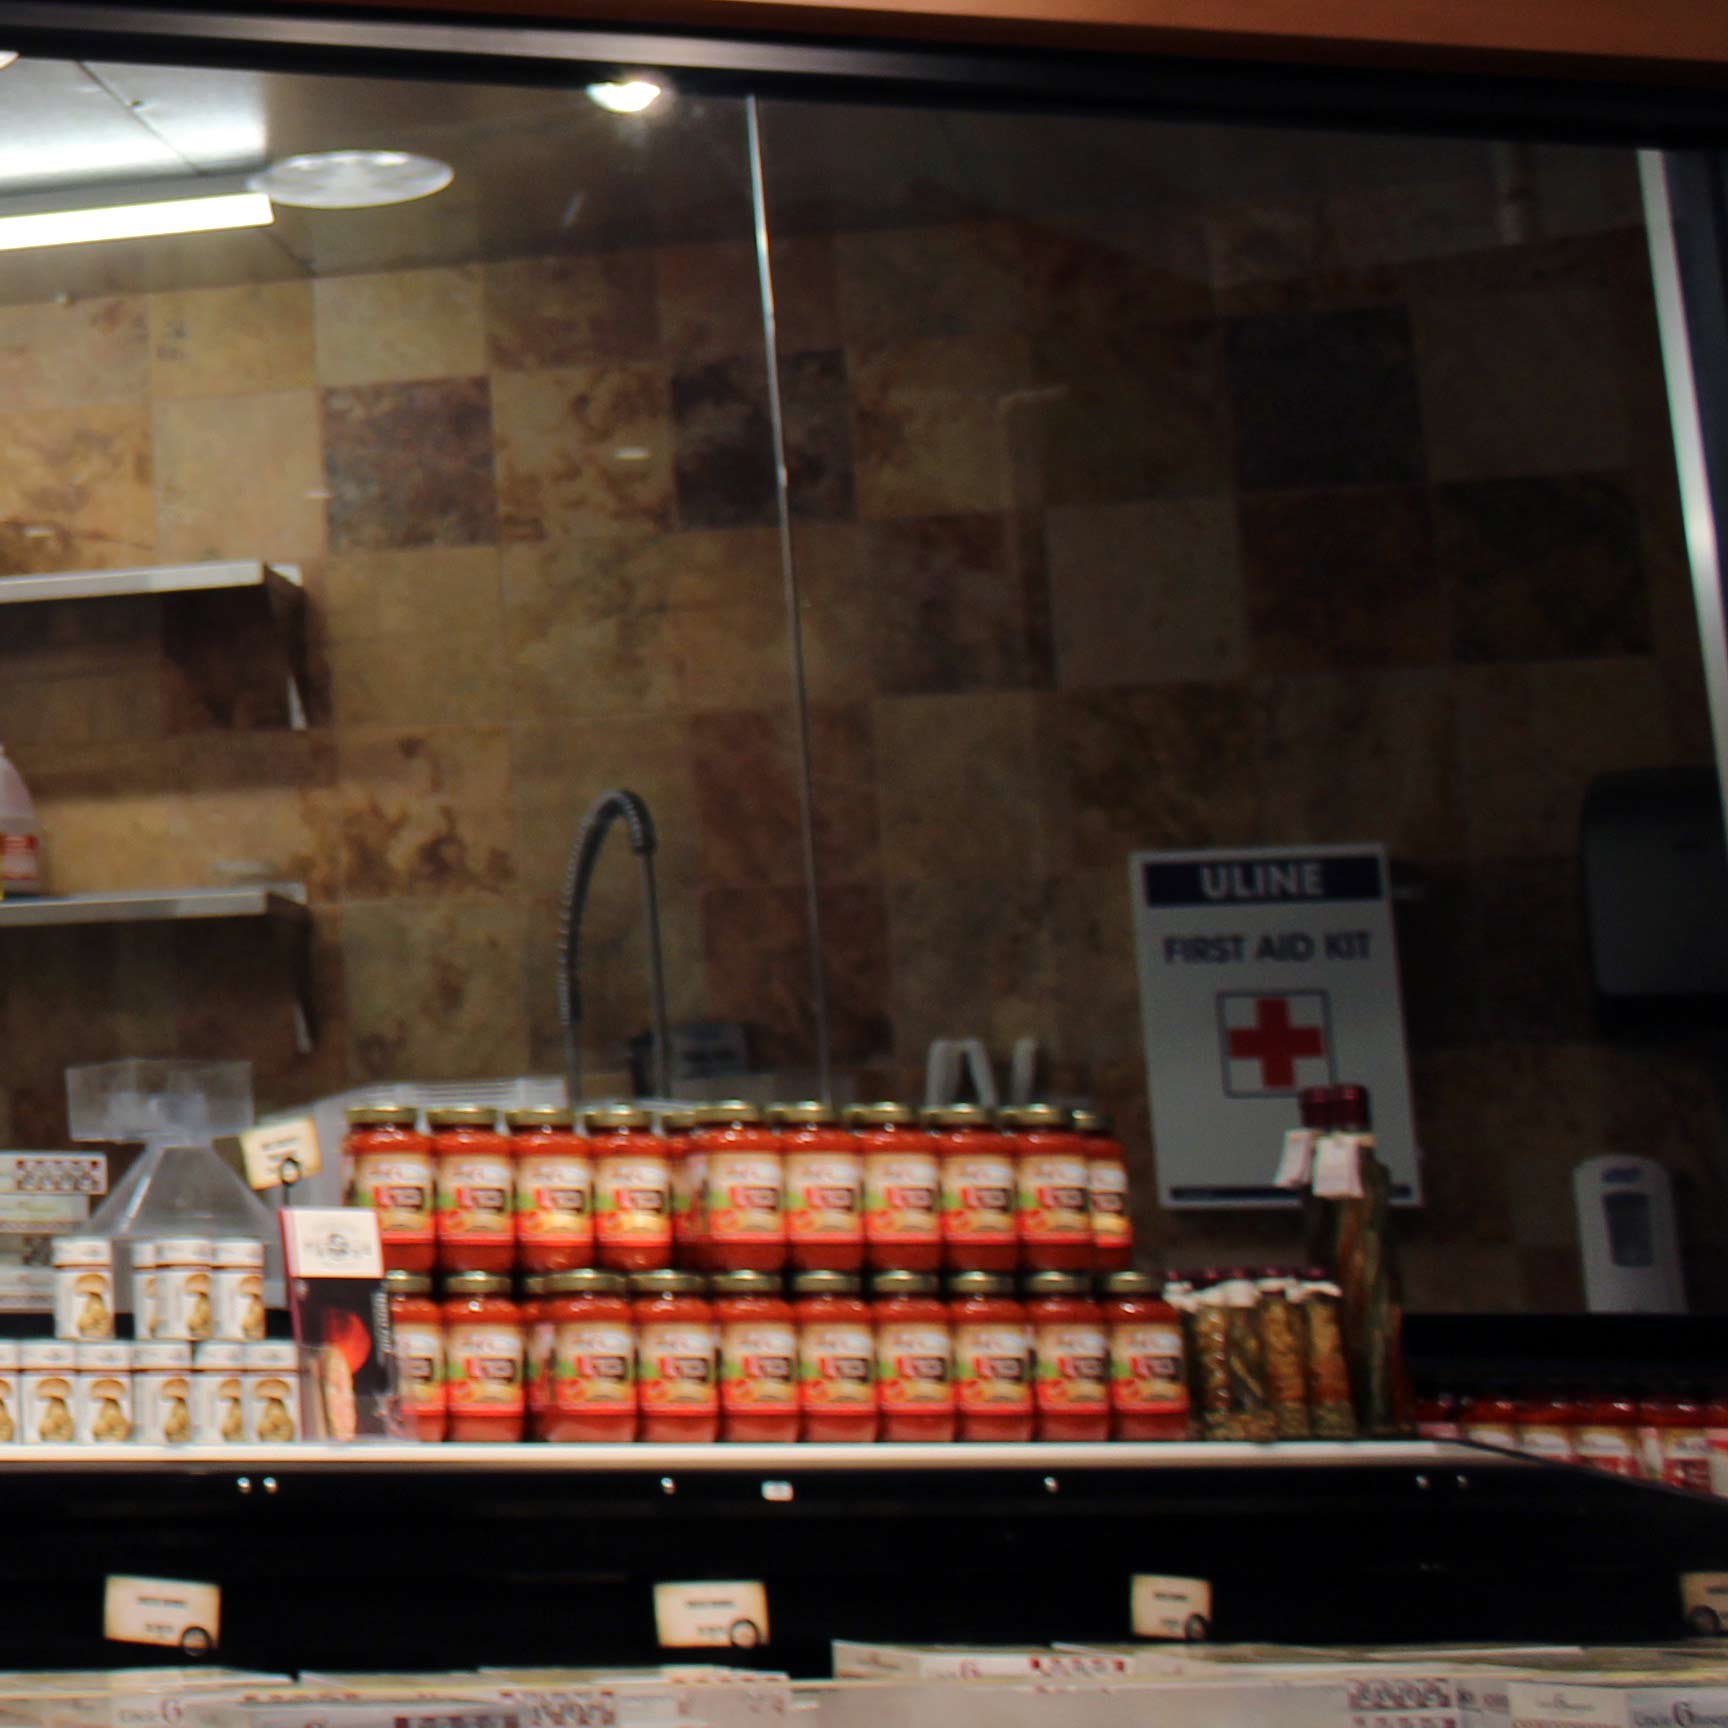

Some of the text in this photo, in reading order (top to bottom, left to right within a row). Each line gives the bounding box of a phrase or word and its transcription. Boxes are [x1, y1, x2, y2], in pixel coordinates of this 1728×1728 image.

[1197, 860, 1325, 899] ULINE
[1164, 929, 1371, 964] FIRST AID KIT
